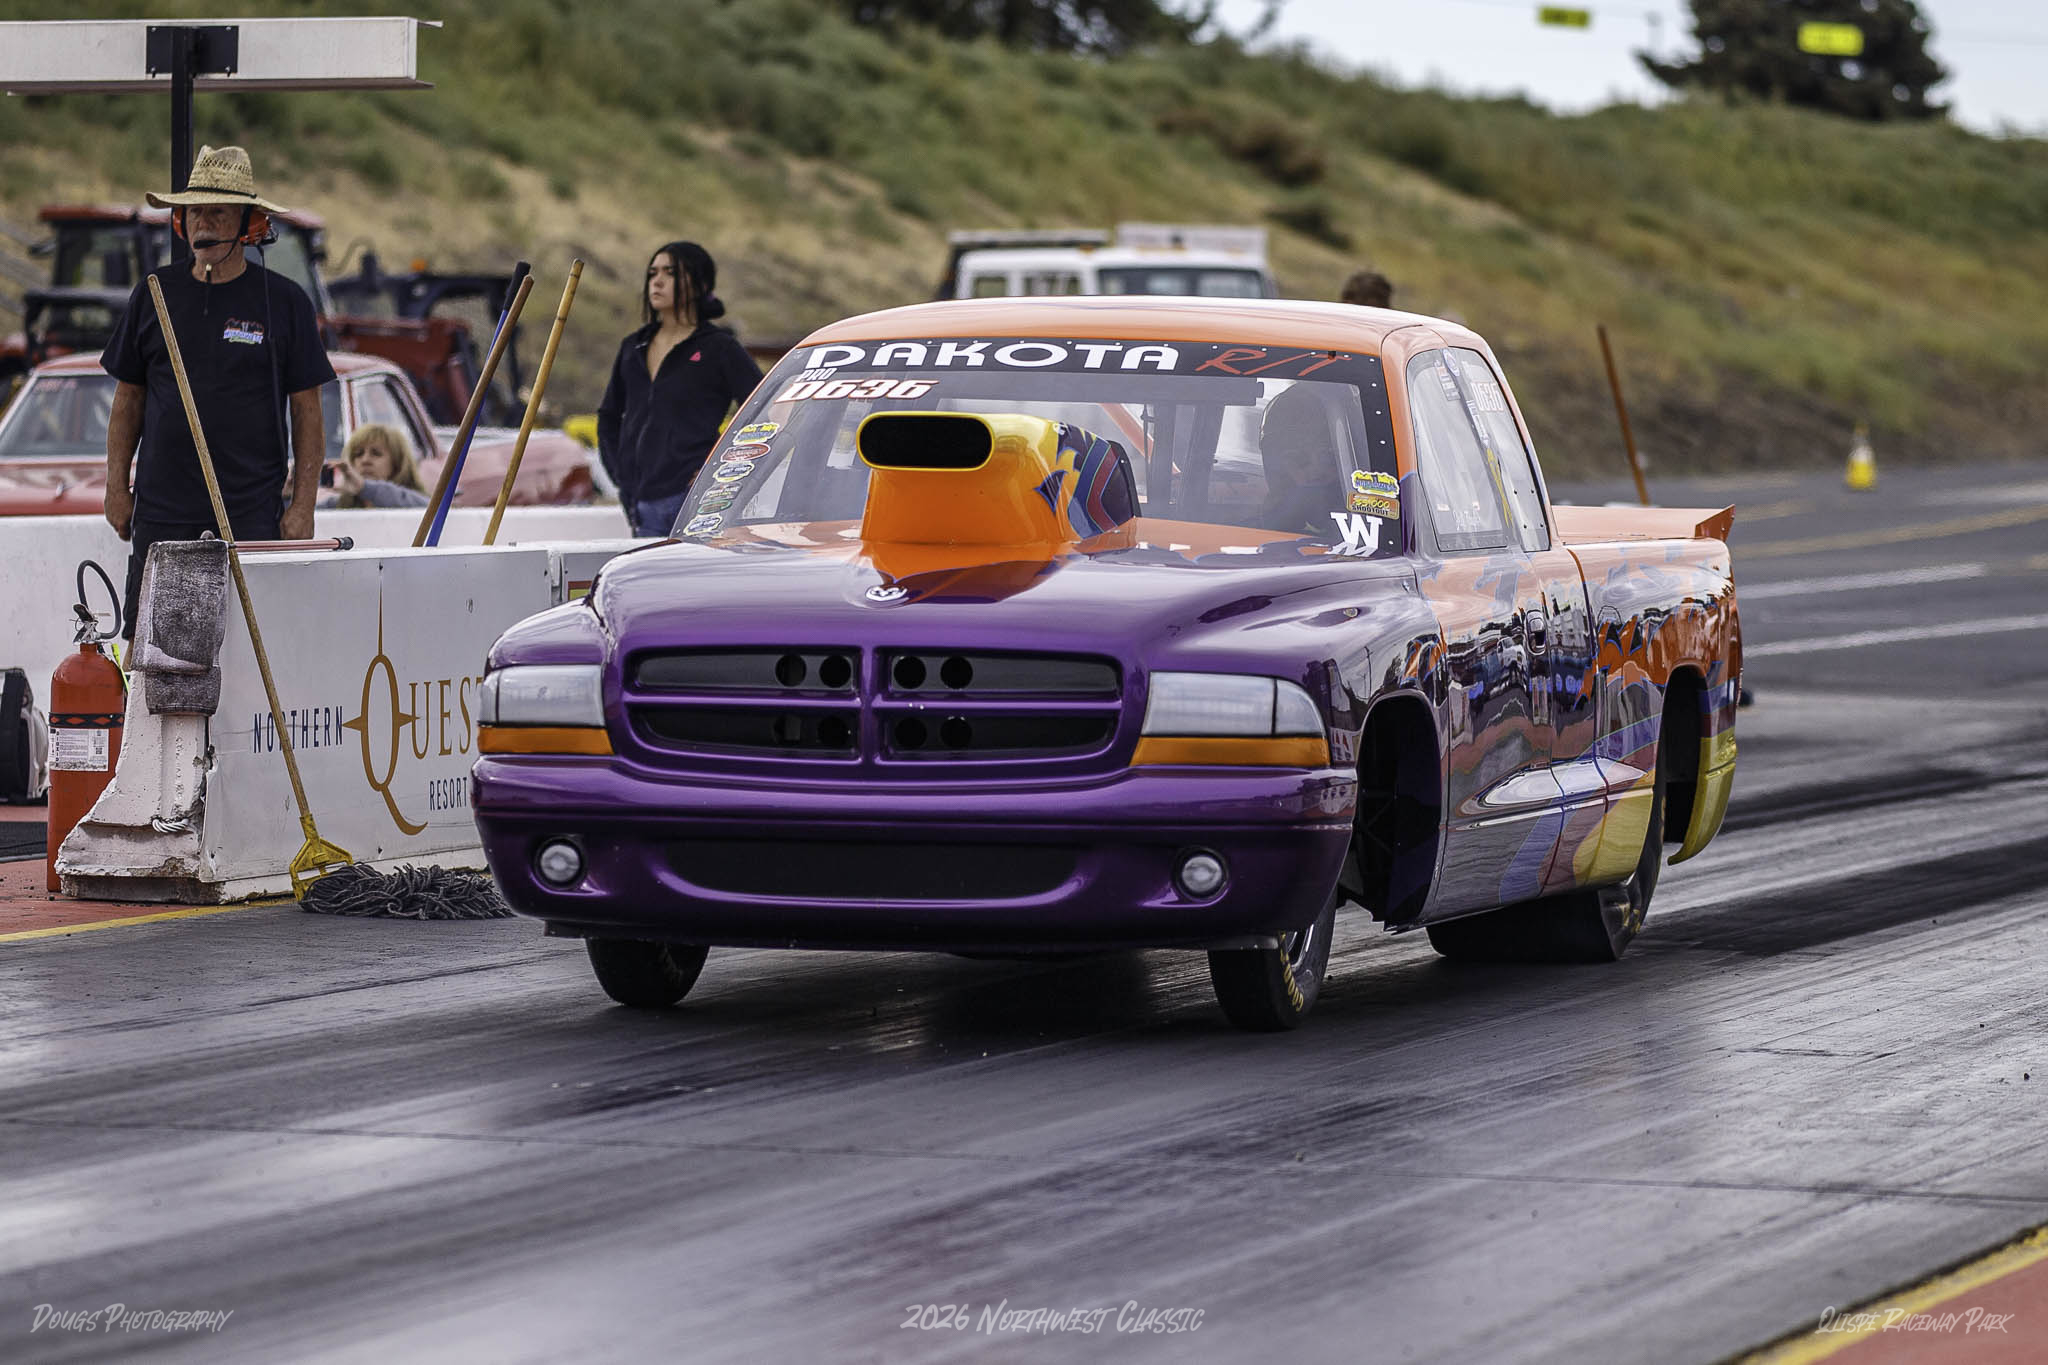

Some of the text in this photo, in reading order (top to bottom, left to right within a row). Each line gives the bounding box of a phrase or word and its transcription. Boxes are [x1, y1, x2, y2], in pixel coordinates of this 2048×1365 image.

[805, 342, 1180, 371] DAKOTA
[795, 367, 838, 382] PRO
[774, 379, 940, 404] D636
[361, 654, 483, 836] QUES
